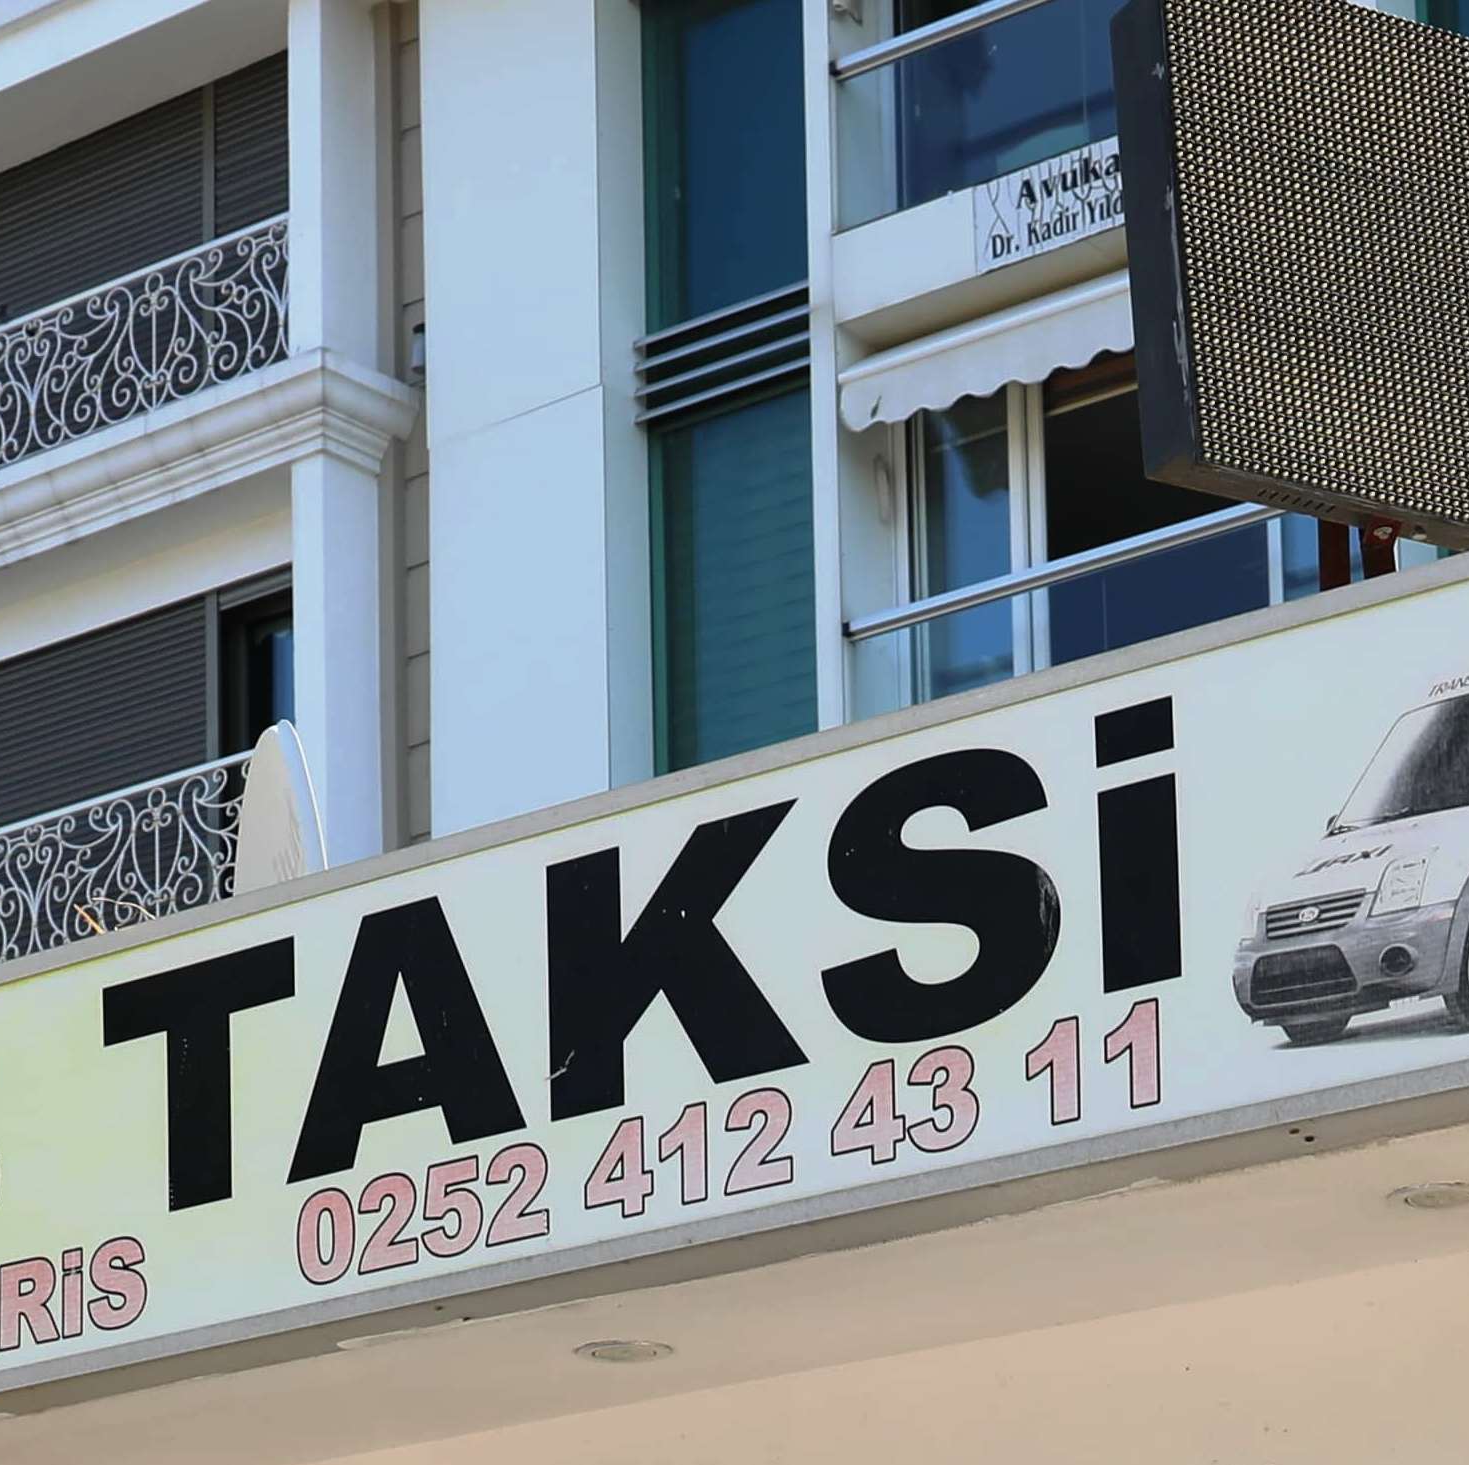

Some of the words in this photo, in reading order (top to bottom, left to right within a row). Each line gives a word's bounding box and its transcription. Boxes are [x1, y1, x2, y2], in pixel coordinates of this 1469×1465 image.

[991, 233, 1020, 259] Dr.
[1027, 206, 1080, 247] Kadir
[296, 1142, 550, 1287] 0252
[583, 1087, 794, 1218] 412
[830, 1045, 980, 1165] 43
[1025, 998, 1162, 1125] 11
